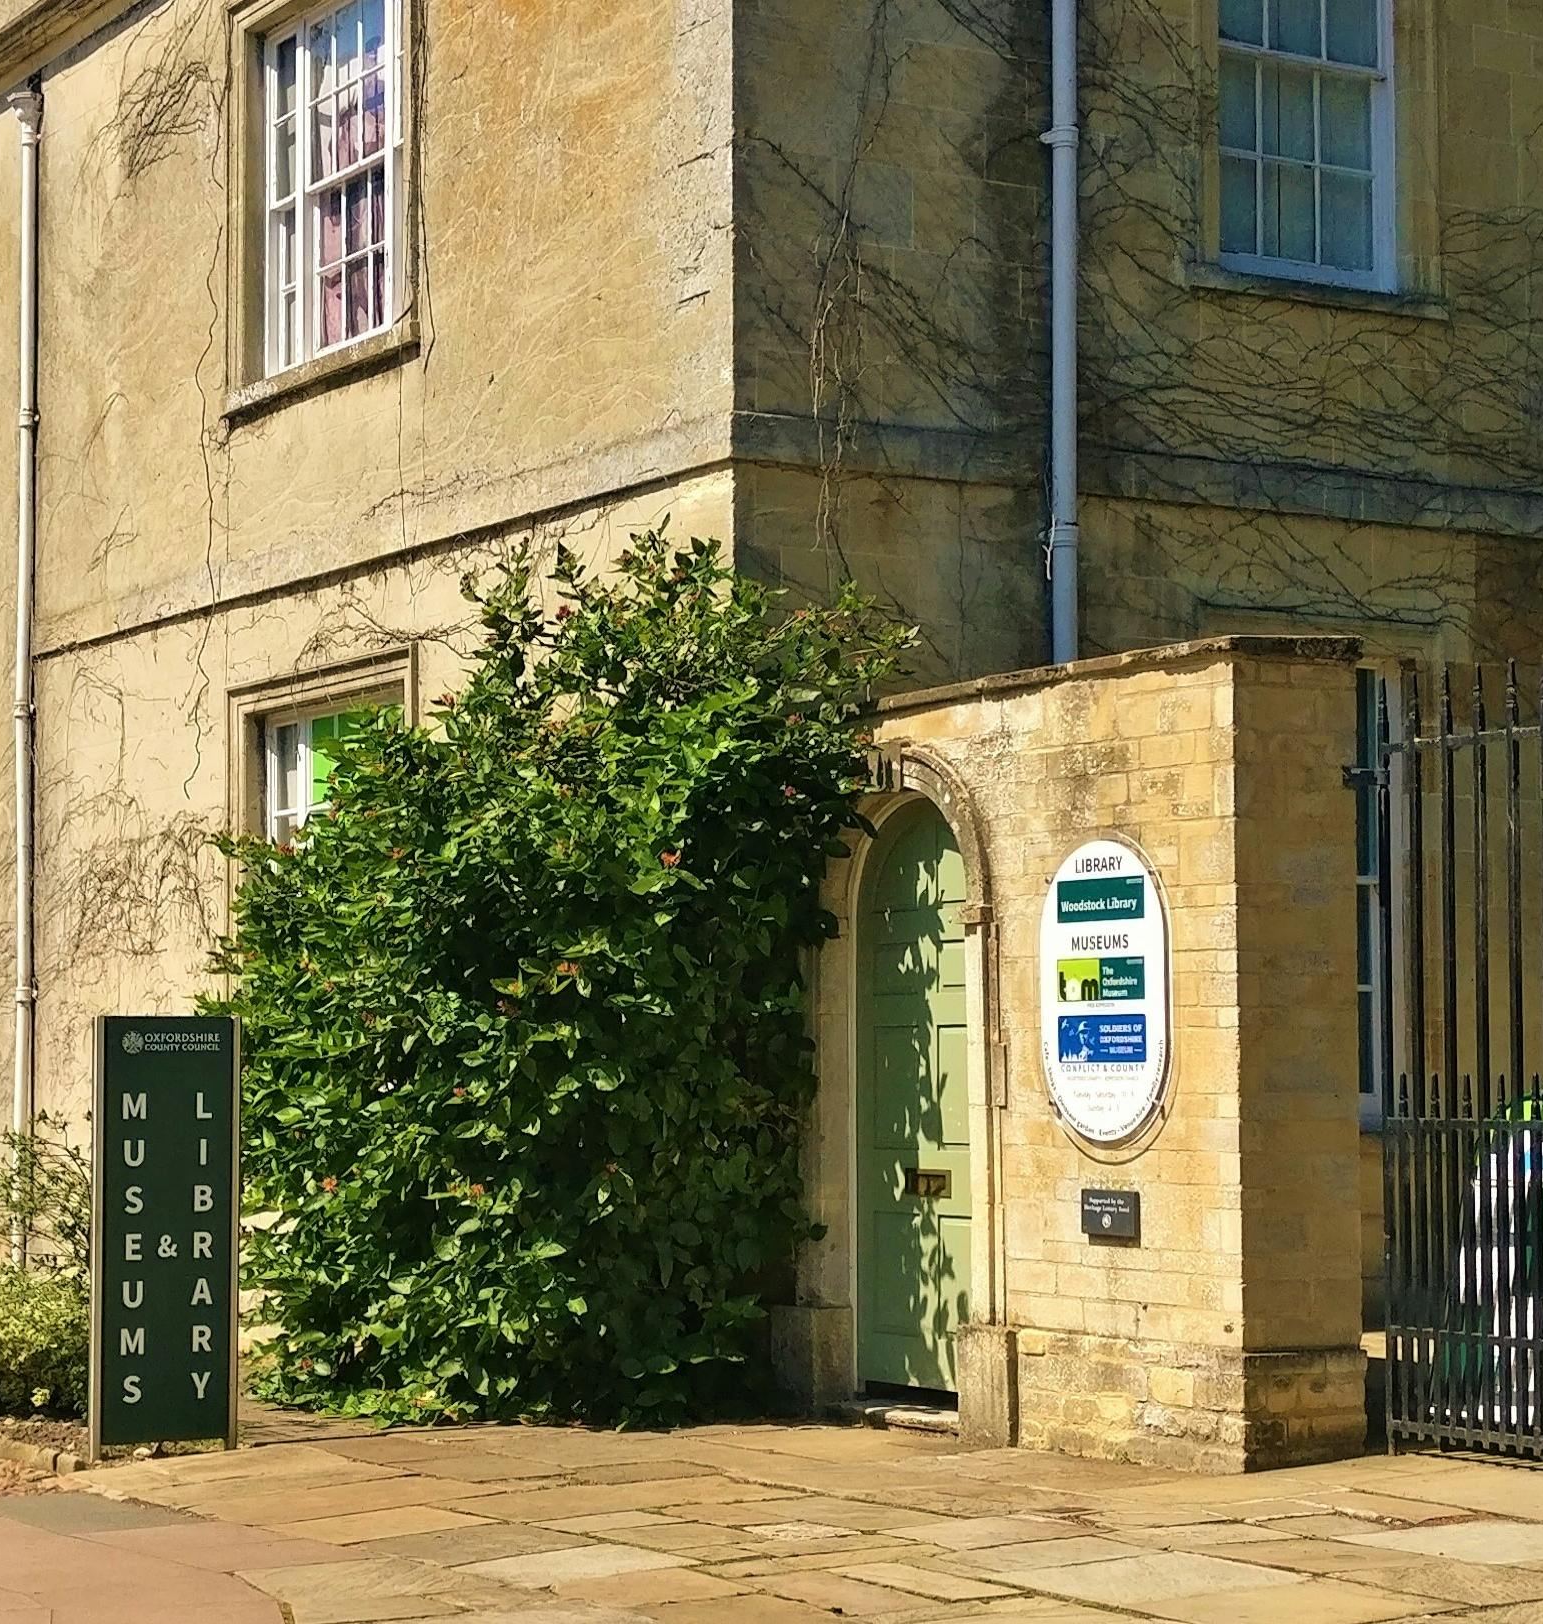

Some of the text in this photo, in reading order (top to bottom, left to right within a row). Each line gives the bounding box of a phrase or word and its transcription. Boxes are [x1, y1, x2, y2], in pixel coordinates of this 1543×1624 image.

[1075, 856, 1123, 874] LIBRARY
[1061, 896, 1138, 913] Woodstock Library
[1071, 934, 1129, 951] MUSEUMS
[1102, 966, 1114, 976] The
[1102, 976, 1138, 986] Oxfordshire
[1102, 988, 1128, 997] Museum
[1099, 1024, 1143, 1033] SOLDIERS OF
[144, 1033, 220, 1043] OXFORDSHIRE
[1099, 1035, 1143, 1044] OXFORDSHIRE
[144, 1043, 220, 1051] COUNTY COUNCIL
[1061, 1063, 1145, 1073] CONFLICT & COUNTY
[120, 1092, 148, 1404] MUSEUMS
[157, 1234, 179, 1259] &
[191, 1091, 213, 1401] LIBRARY
